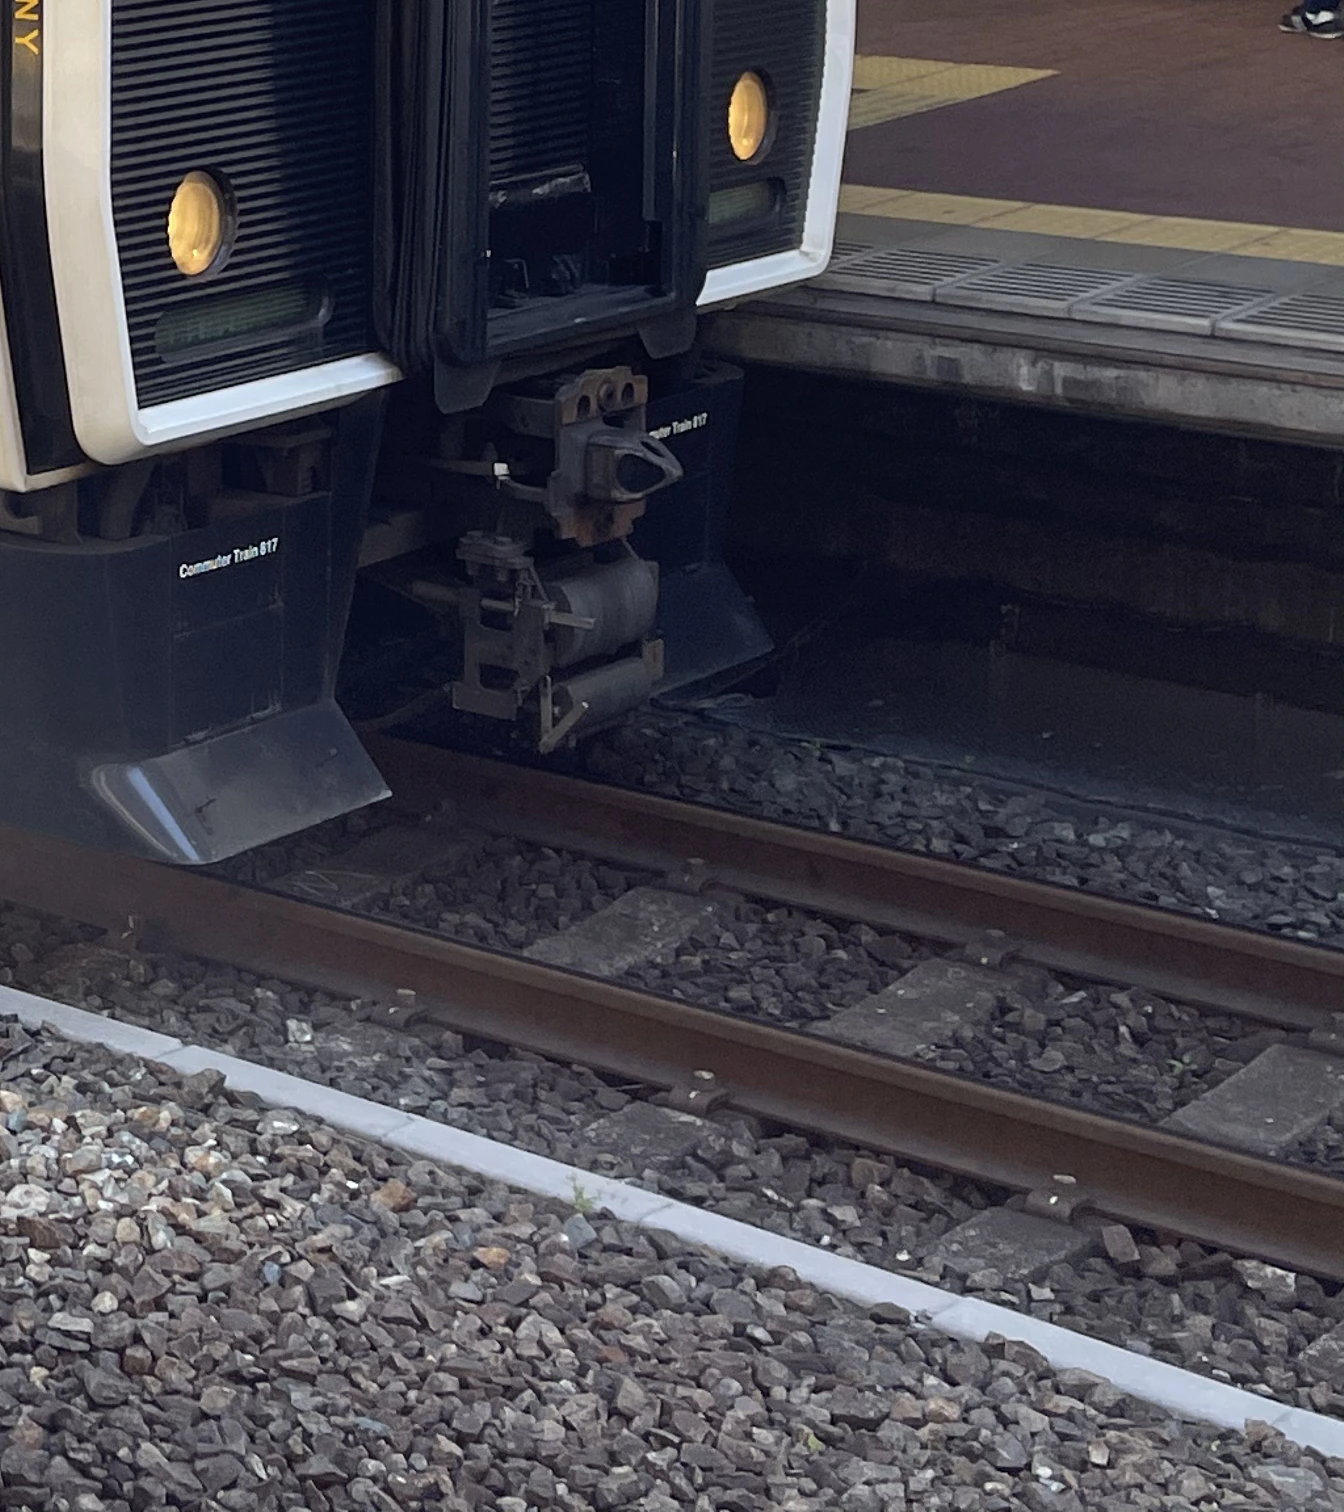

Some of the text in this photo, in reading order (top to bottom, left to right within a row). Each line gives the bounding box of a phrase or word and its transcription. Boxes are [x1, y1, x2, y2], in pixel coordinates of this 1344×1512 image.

[179, 537, 279, 579] Commuter Train 817
